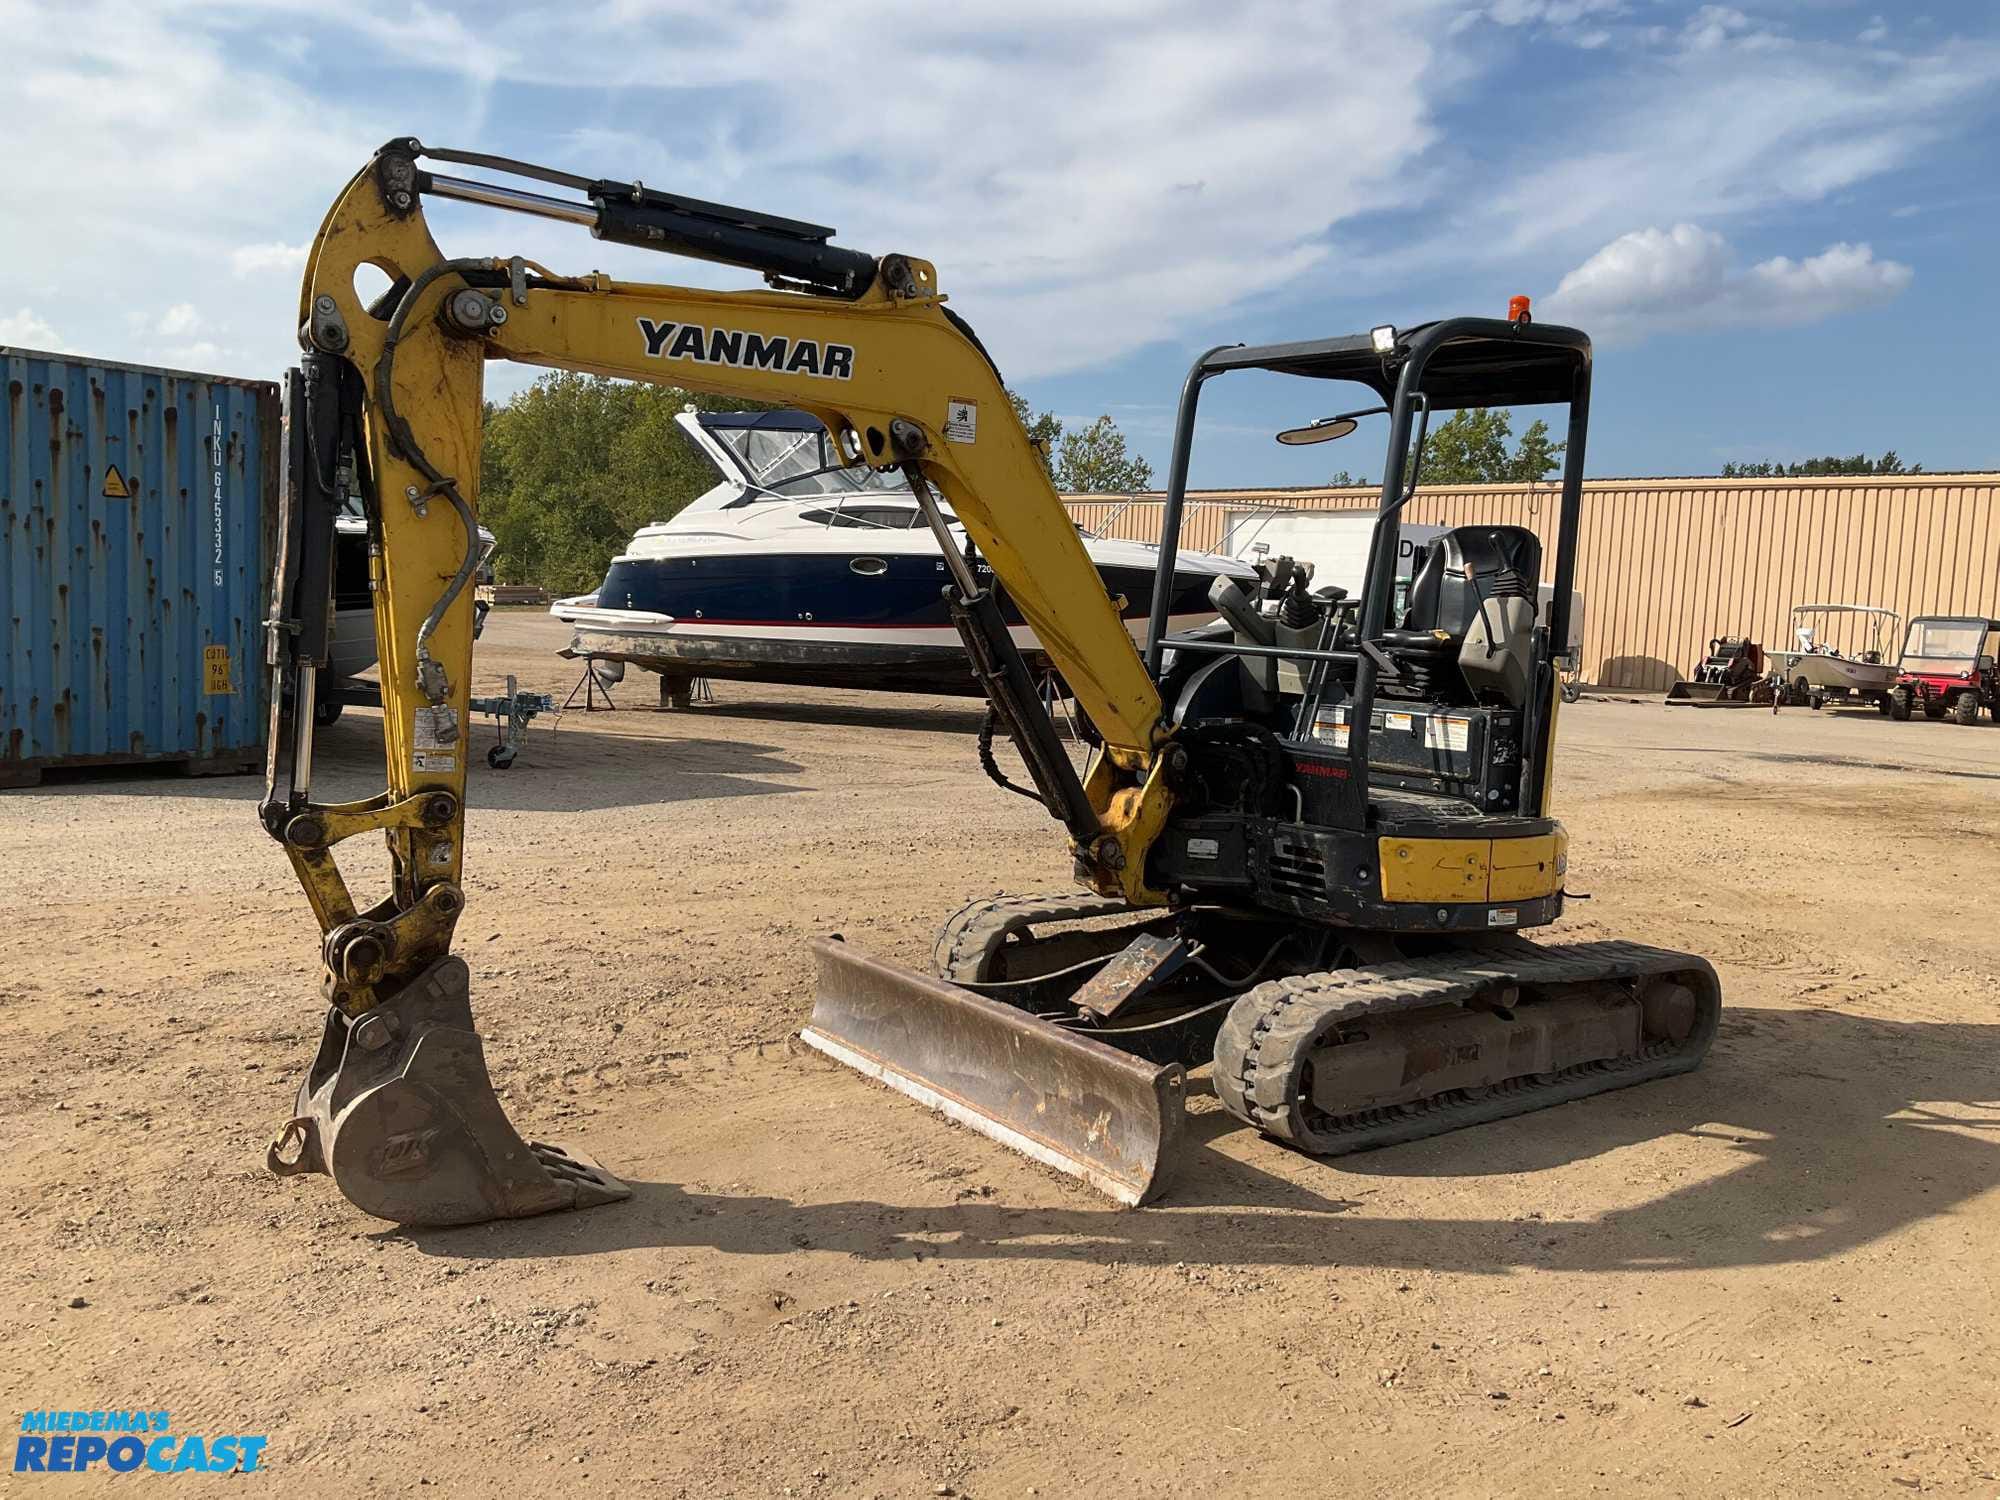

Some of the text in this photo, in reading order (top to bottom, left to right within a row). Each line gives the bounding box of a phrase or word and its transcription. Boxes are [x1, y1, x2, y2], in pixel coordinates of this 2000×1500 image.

[637, 318, 855, 380] YANMAR
[213, 404, 222, 467] INKU
[213, 471, 223, 564] 645332
